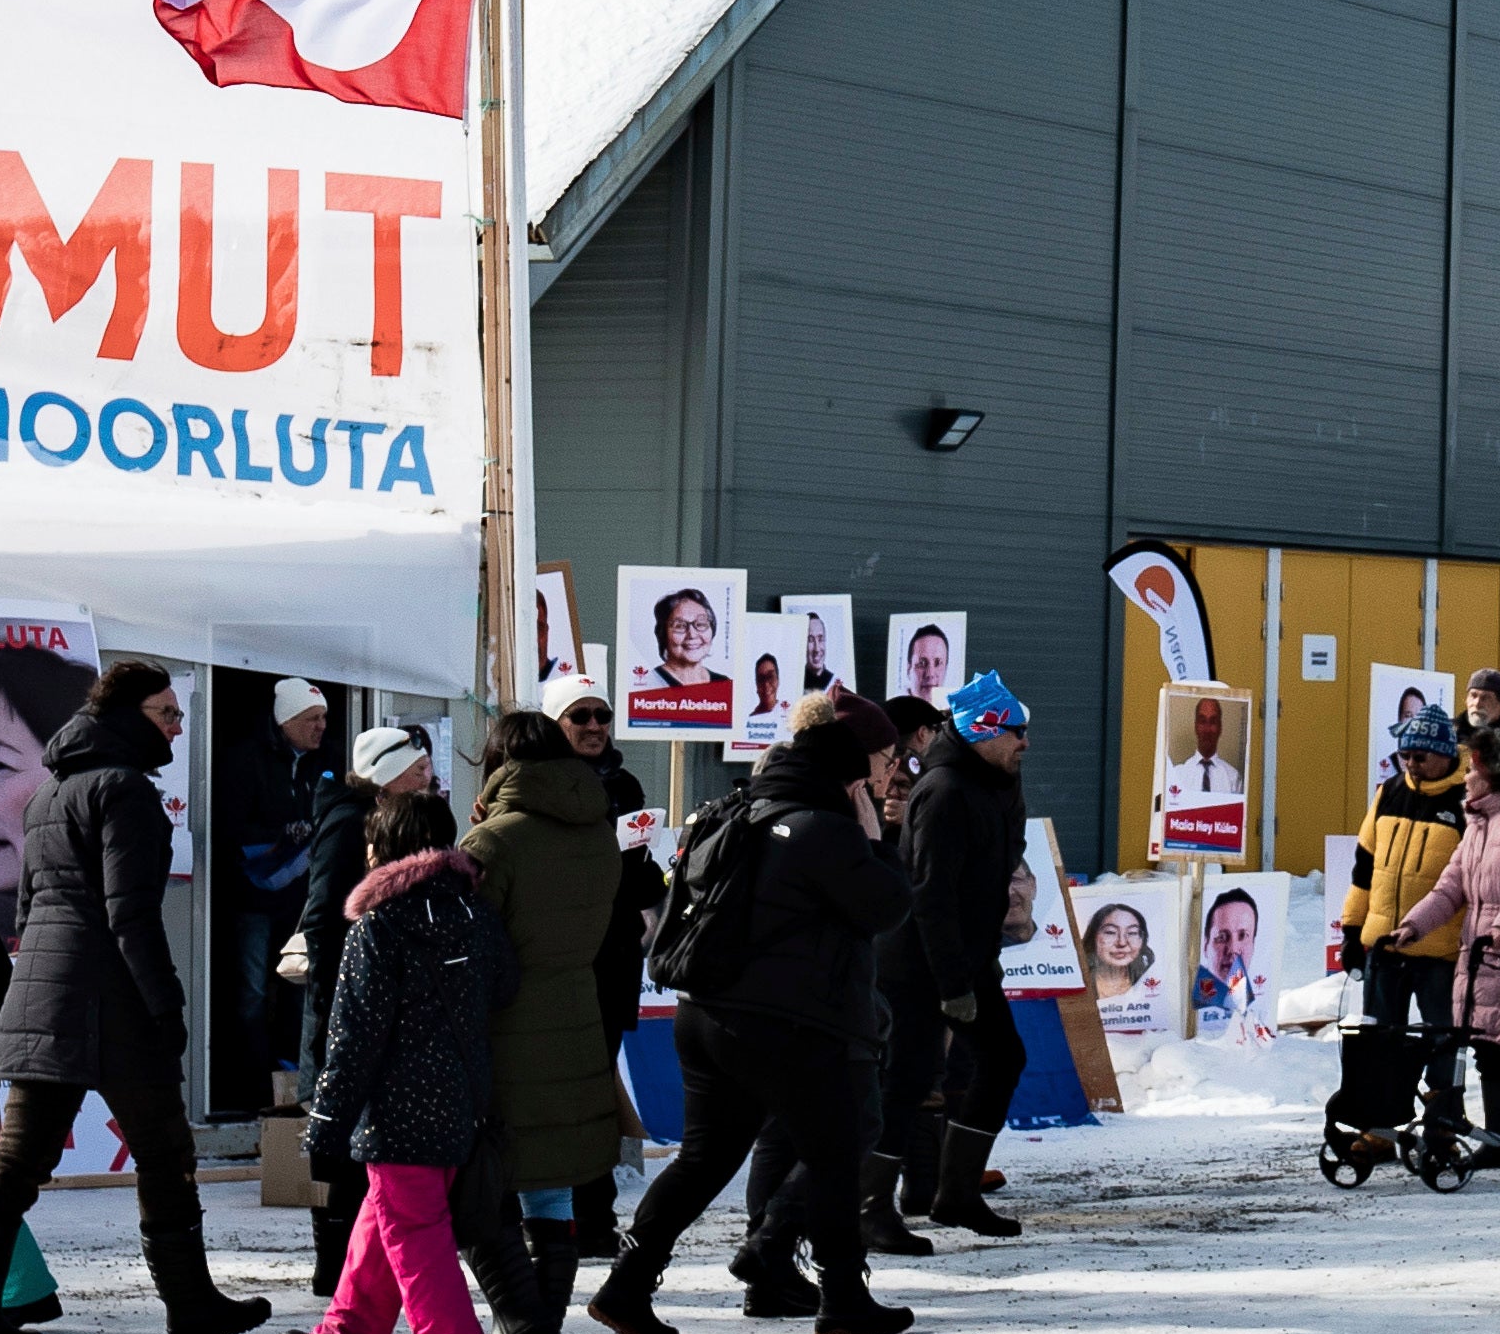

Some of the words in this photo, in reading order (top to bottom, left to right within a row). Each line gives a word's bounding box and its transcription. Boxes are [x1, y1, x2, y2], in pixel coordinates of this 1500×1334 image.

[634, 698, 677, 711] Martha
[679, 699, 727, 712] Abelsen
[1037, 963, 1074, 976] Olsen
[1126, 1002, 1150, 1011] Ane
